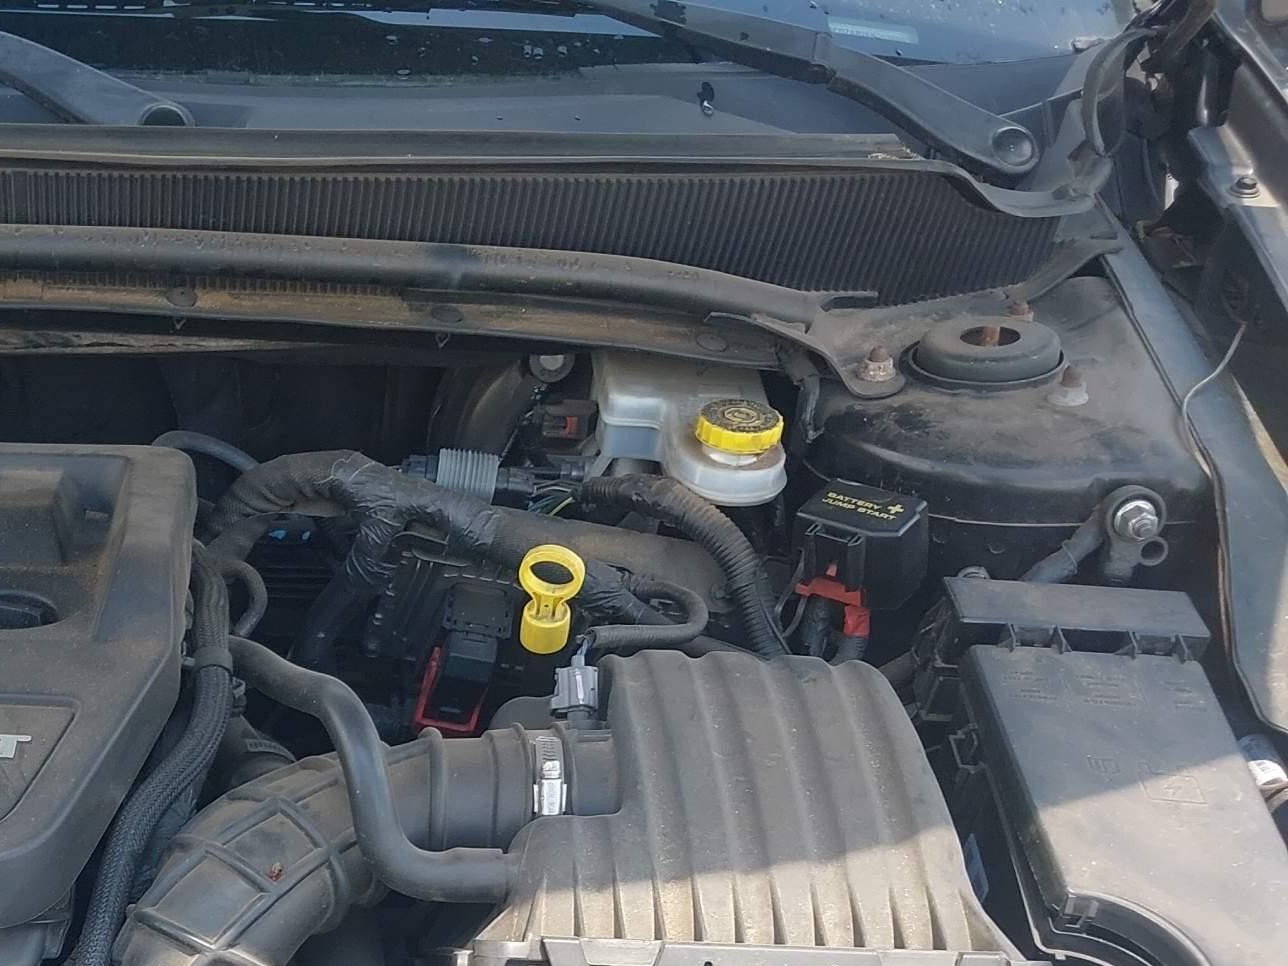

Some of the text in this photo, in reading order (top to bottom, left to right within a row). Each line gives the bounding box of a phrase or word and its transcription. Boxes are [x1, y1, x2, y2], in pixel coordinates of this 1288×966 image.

[822, 498, 897, 520] JUMP START
[827, 492, 882, 510] BATTERY
